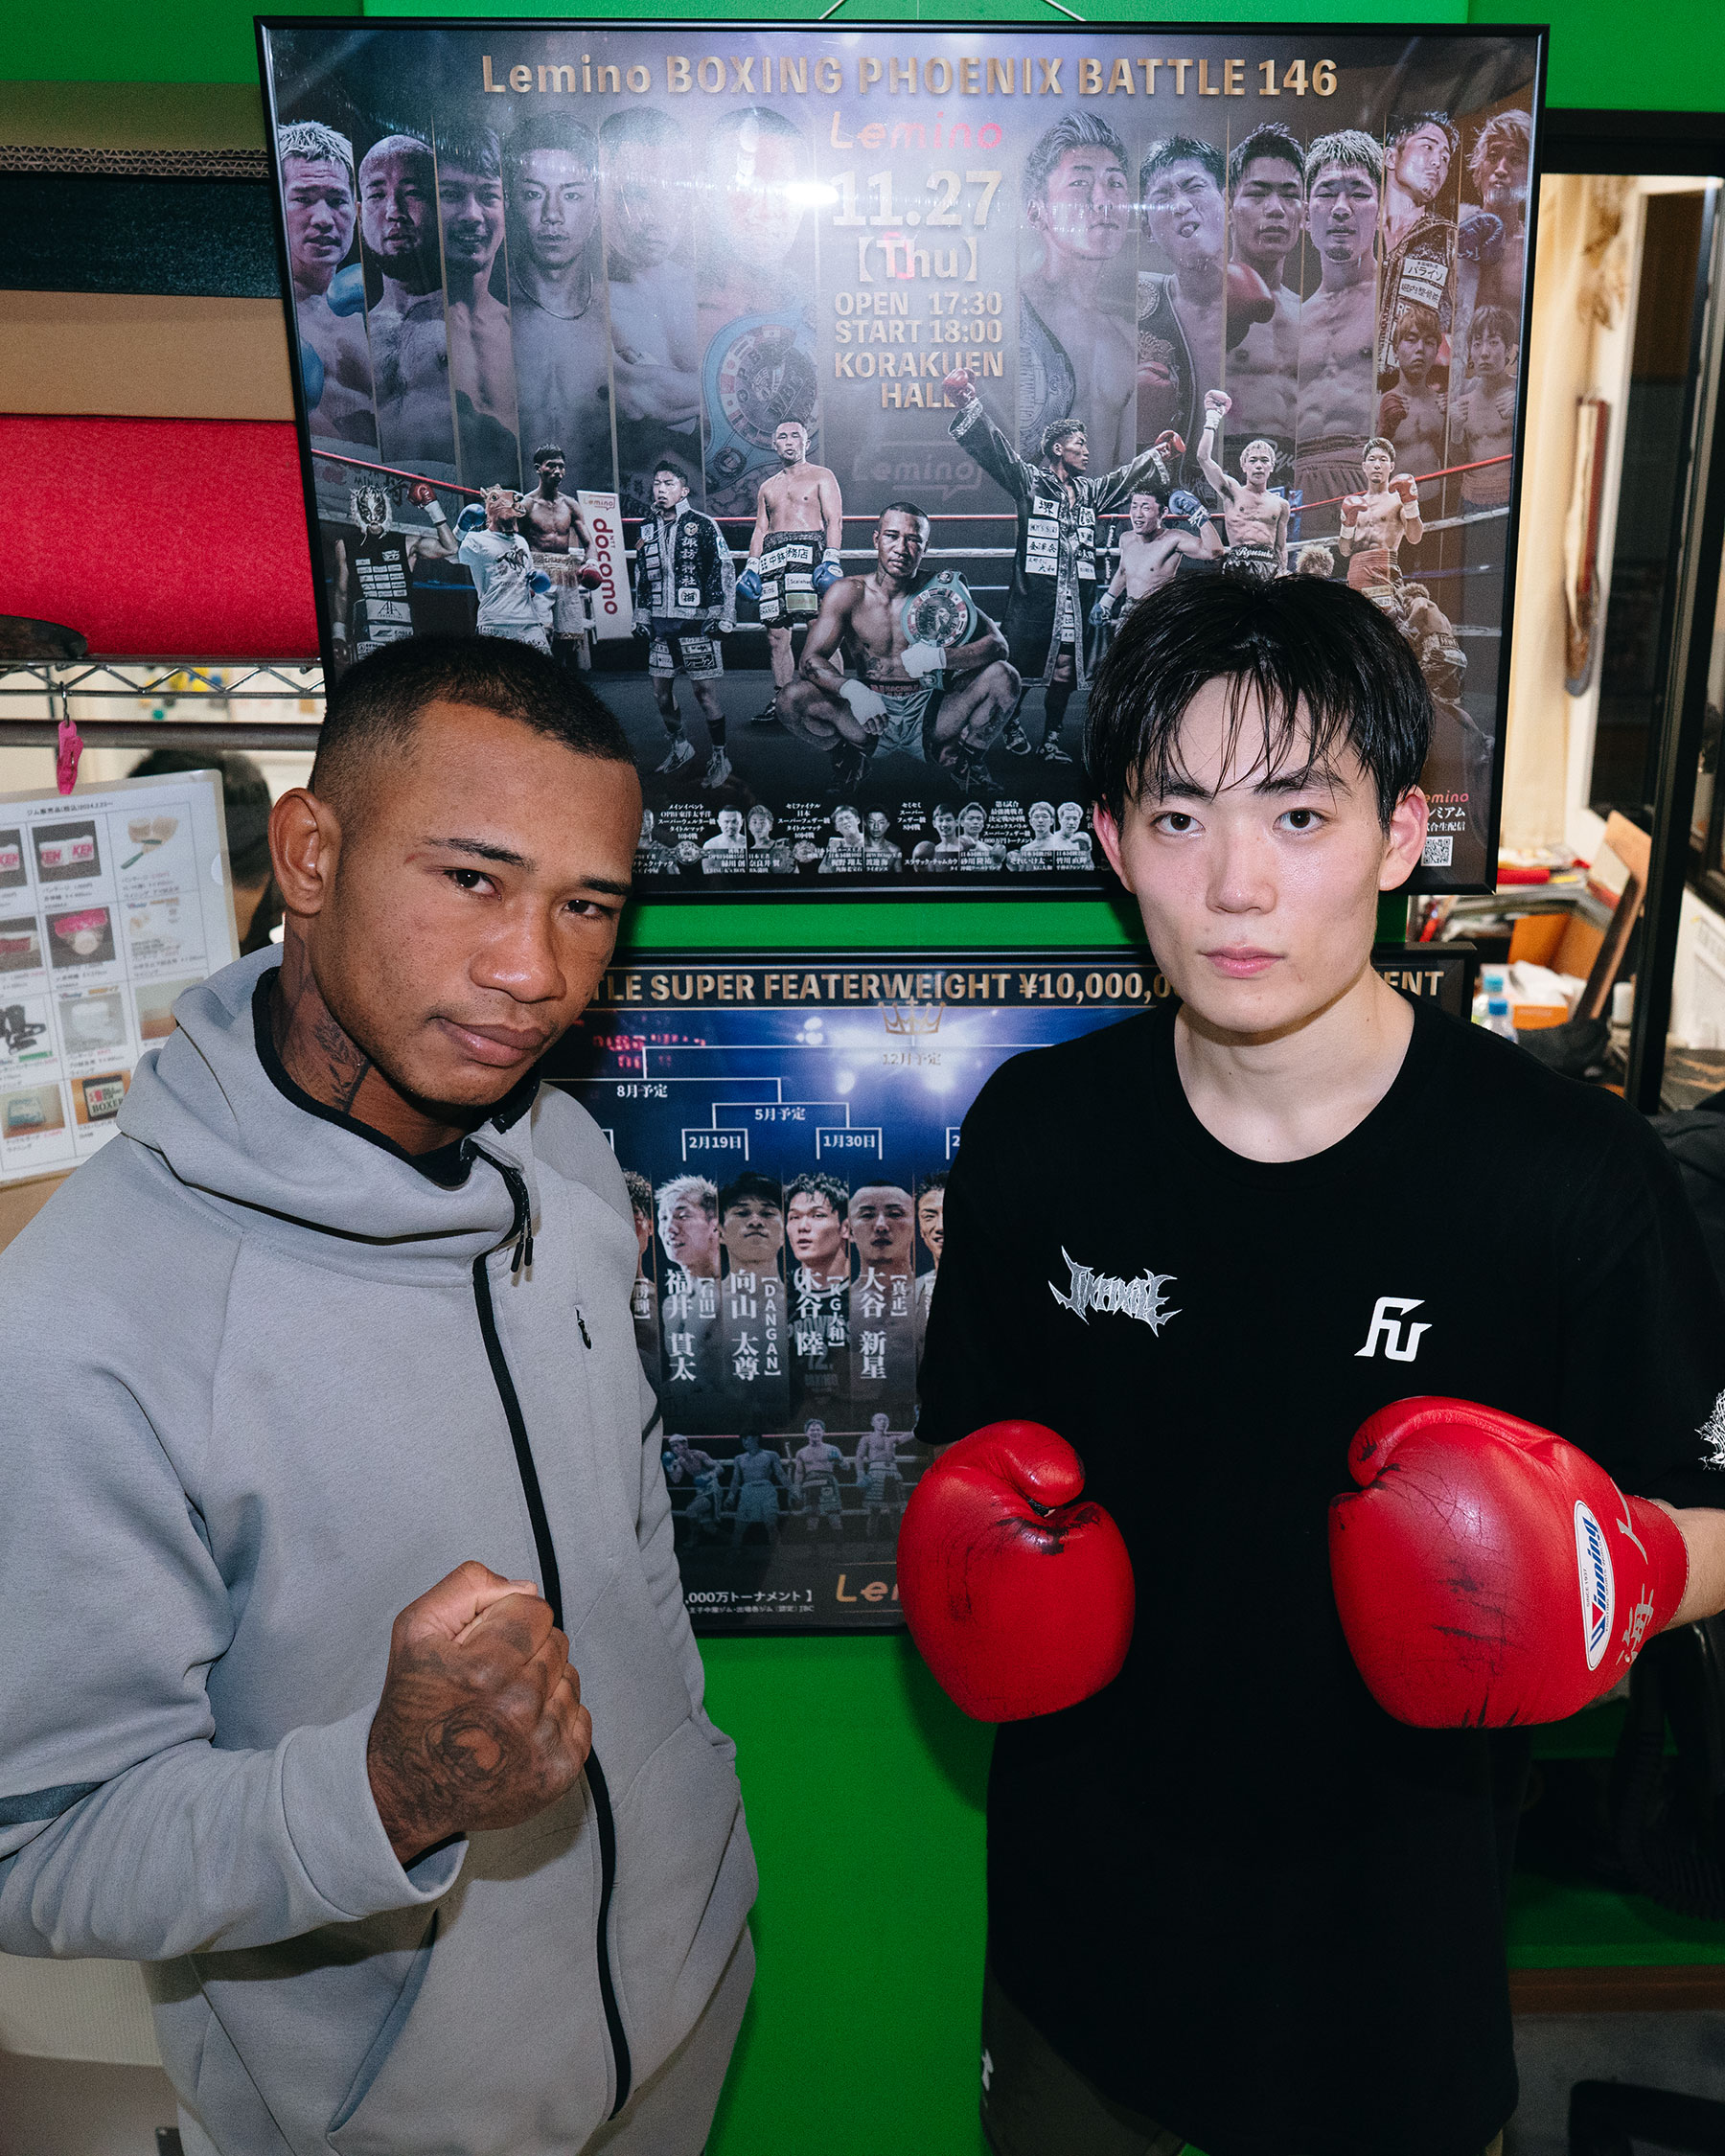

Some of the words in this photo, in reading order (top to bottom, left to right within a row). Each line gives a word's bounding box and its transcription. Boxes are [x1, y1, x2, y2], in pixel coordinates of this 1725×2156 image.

[481, 54, 652, 94] Lemino
[666, 56, 843, 95] BOXING
[859, 57, 1064, 96] PHOENIX
[1078, 57, 1246, 96] BATTLE
[1257, 58, 1339, 96] 146
[829, 110, 1003, 149] Lemino
[830, 170, 1003, 227] 11.27
[835, 291, 909, 316] OPEN
[928, 290, 1003, 316] 17:30
[835, 319, 921, 343] START
[929, 318, 1003, 343] 18:00
[835, 351, 1004, 378] KORAKUEN
[592, 517, 618, 615] docomo
[650, 973, 755, 1001] SUPER
[764, 972, 1012, 1001] FEATERWEIGHT
[1383, 970, 1445, 997] ENT
[616, 1084, 668, 1098] 8月予定
[754, 1108, 806, 1122] 5月予定
[688, 1135, 742, 1150] 2月19日
[822, 1135, 876, 1149] 1月30日
[730, 1268, 757, 1320] 向山
[684, 1589, 813, 1605] ,000万トーナメント】
